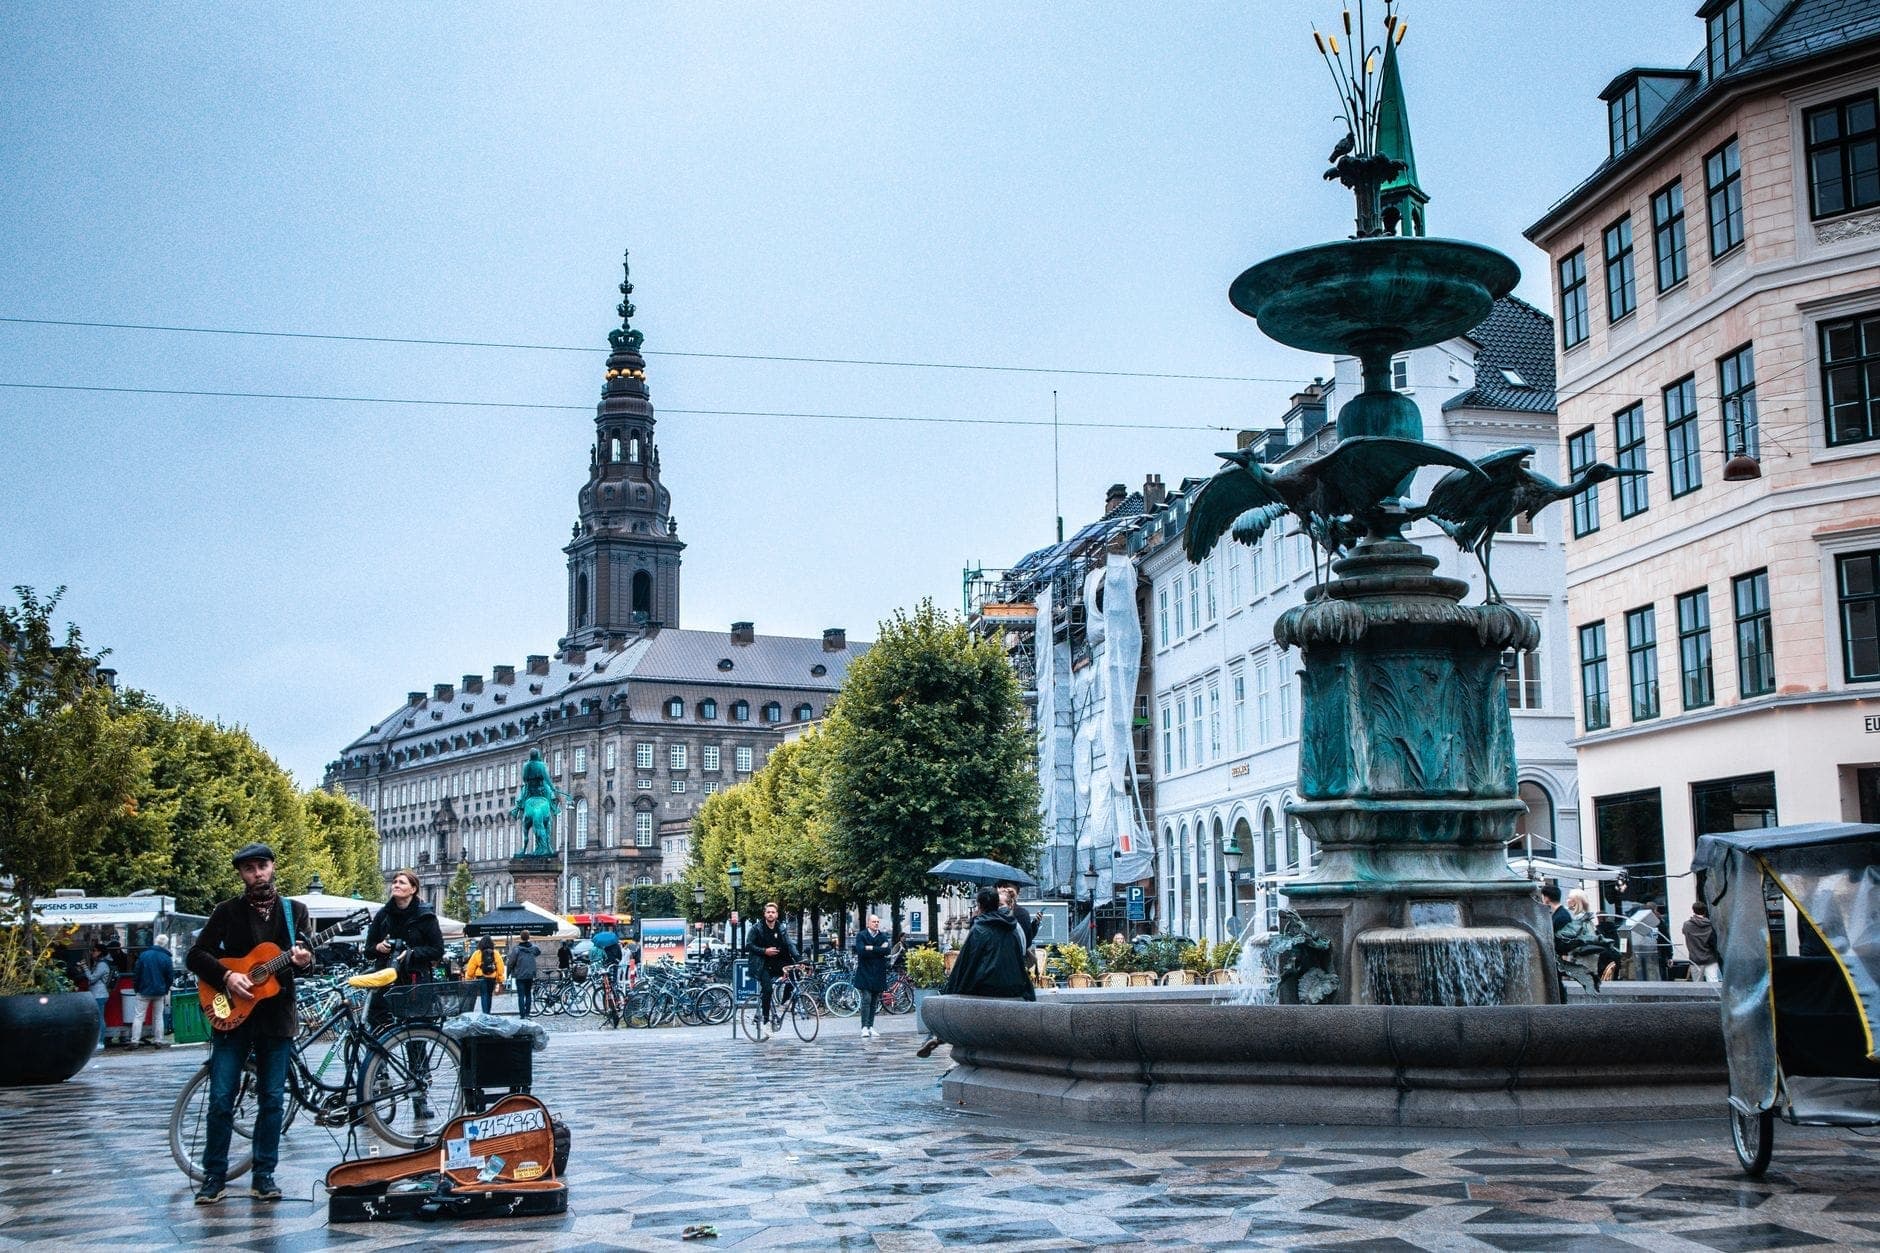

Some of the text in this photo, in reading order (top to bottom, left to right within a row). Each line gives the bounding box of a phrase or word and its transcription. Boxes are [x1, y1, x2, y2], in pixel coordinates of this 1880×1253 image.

[1132, 888, 1141, 901] P
[913, 912, 920, 921] P
[660, 934, 683, 942] proud
